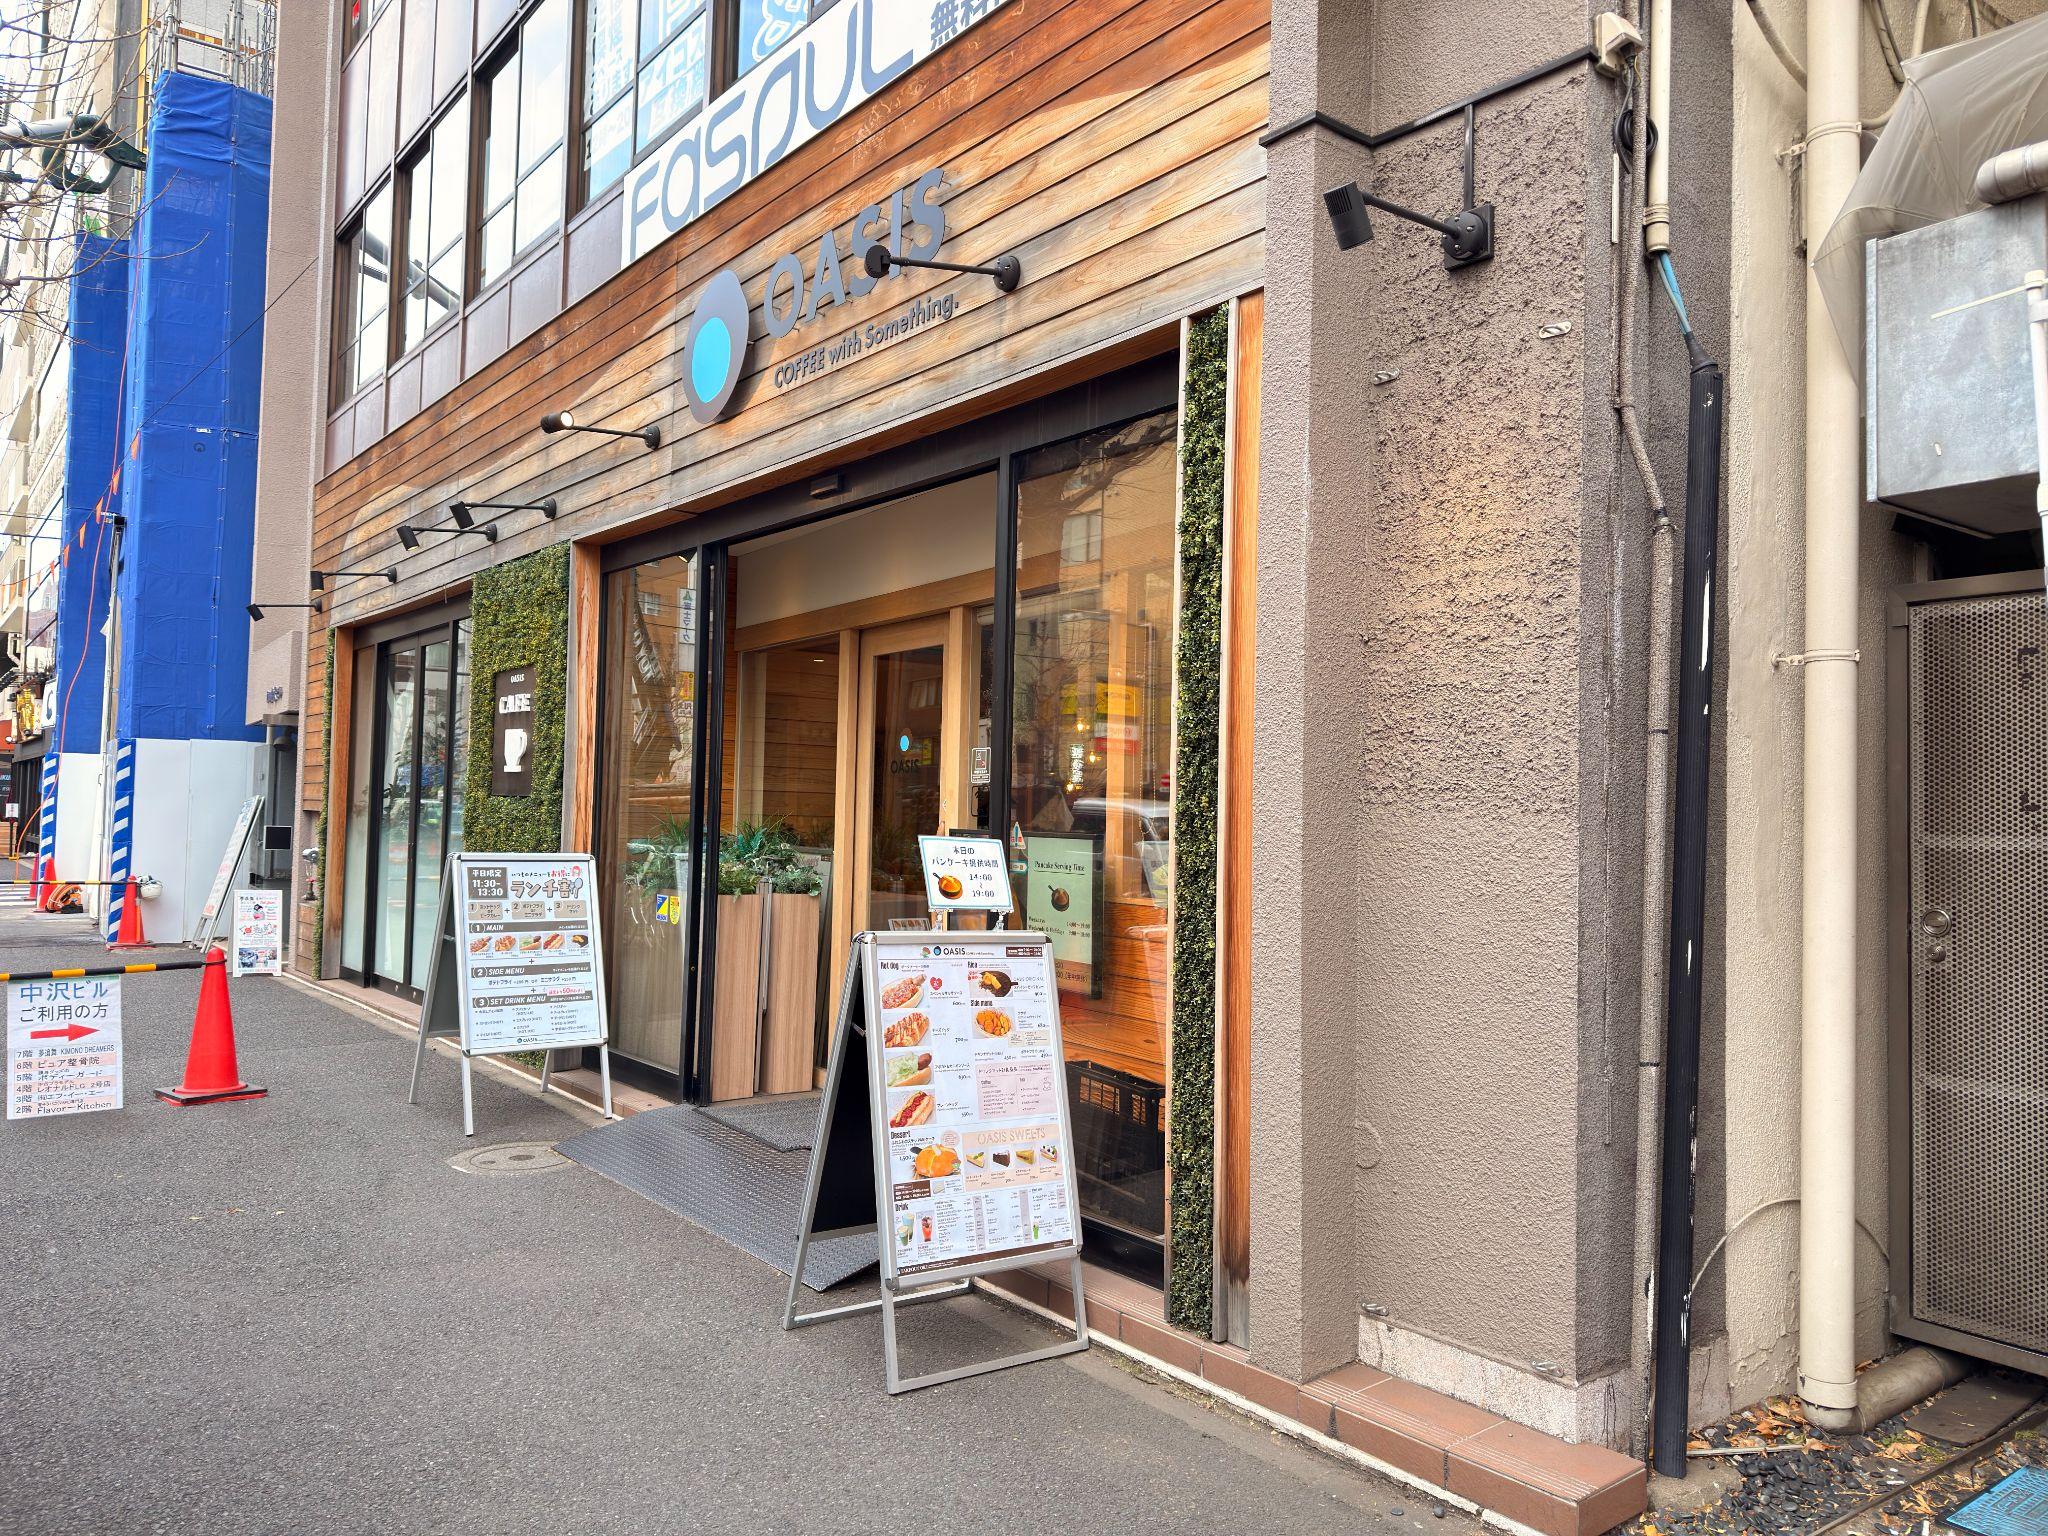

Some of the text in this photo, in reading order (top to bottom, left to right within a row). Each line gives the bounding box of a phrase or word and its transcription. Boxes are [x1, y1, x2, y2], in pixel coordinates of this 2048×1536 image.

[930, 0, 999, 51] 無料
[763, 167, 946, 339] OASIS
[774, 292, 959, 388] COFFEE with Something.
[510, 674, 525, 683] OASIS
[499, 693, 531, 714] CAFE
[891, 759, 919, 774] OASIS
[953, 846, 975, 855] 本日の
[472, 869, 502, 878] 平日限定
[478, 888, 503, 896] 13:30
[972, 890, 995, 898] 19:00
[943, 947, 966, 956] OASIS
[21, 980, 108, 1003] 中沢ビル
[527, 995, 547, 1003] MENU
[21, 1003, 108, 1022] ご利用の方
[85, 1045, 115, 1053] DREAMERS
[977, 1128, 1046, 1144] OASIS SWEETS
